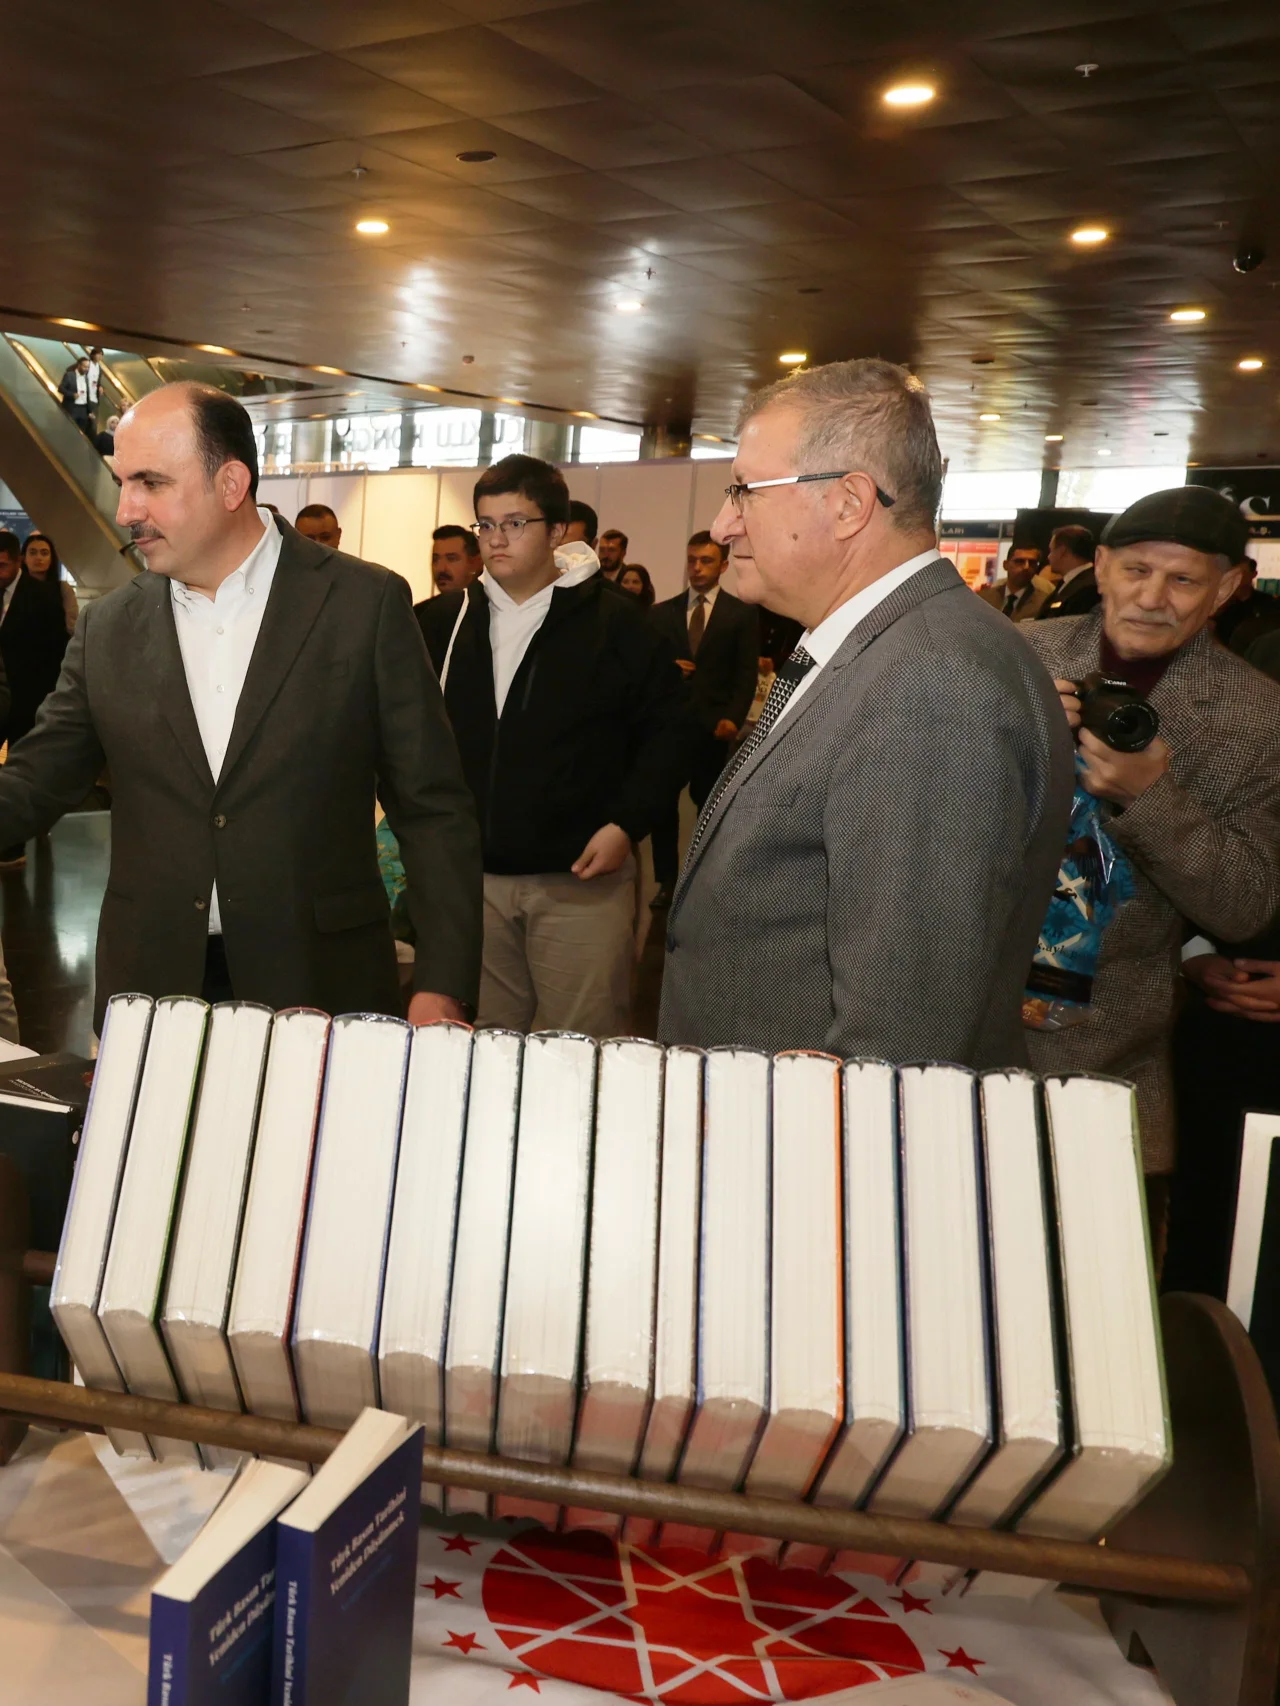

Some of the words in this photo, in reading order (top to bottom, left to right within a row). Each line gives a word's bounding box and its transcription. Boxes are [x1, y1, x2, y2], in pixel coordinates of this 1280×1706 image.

[330, 1544, 351, 1573] Türk
[288, 1580, 298, 1606] Türk
[209, 1609, 233, 1643] Türk
[162, 1653, 174, 1680] Türk
